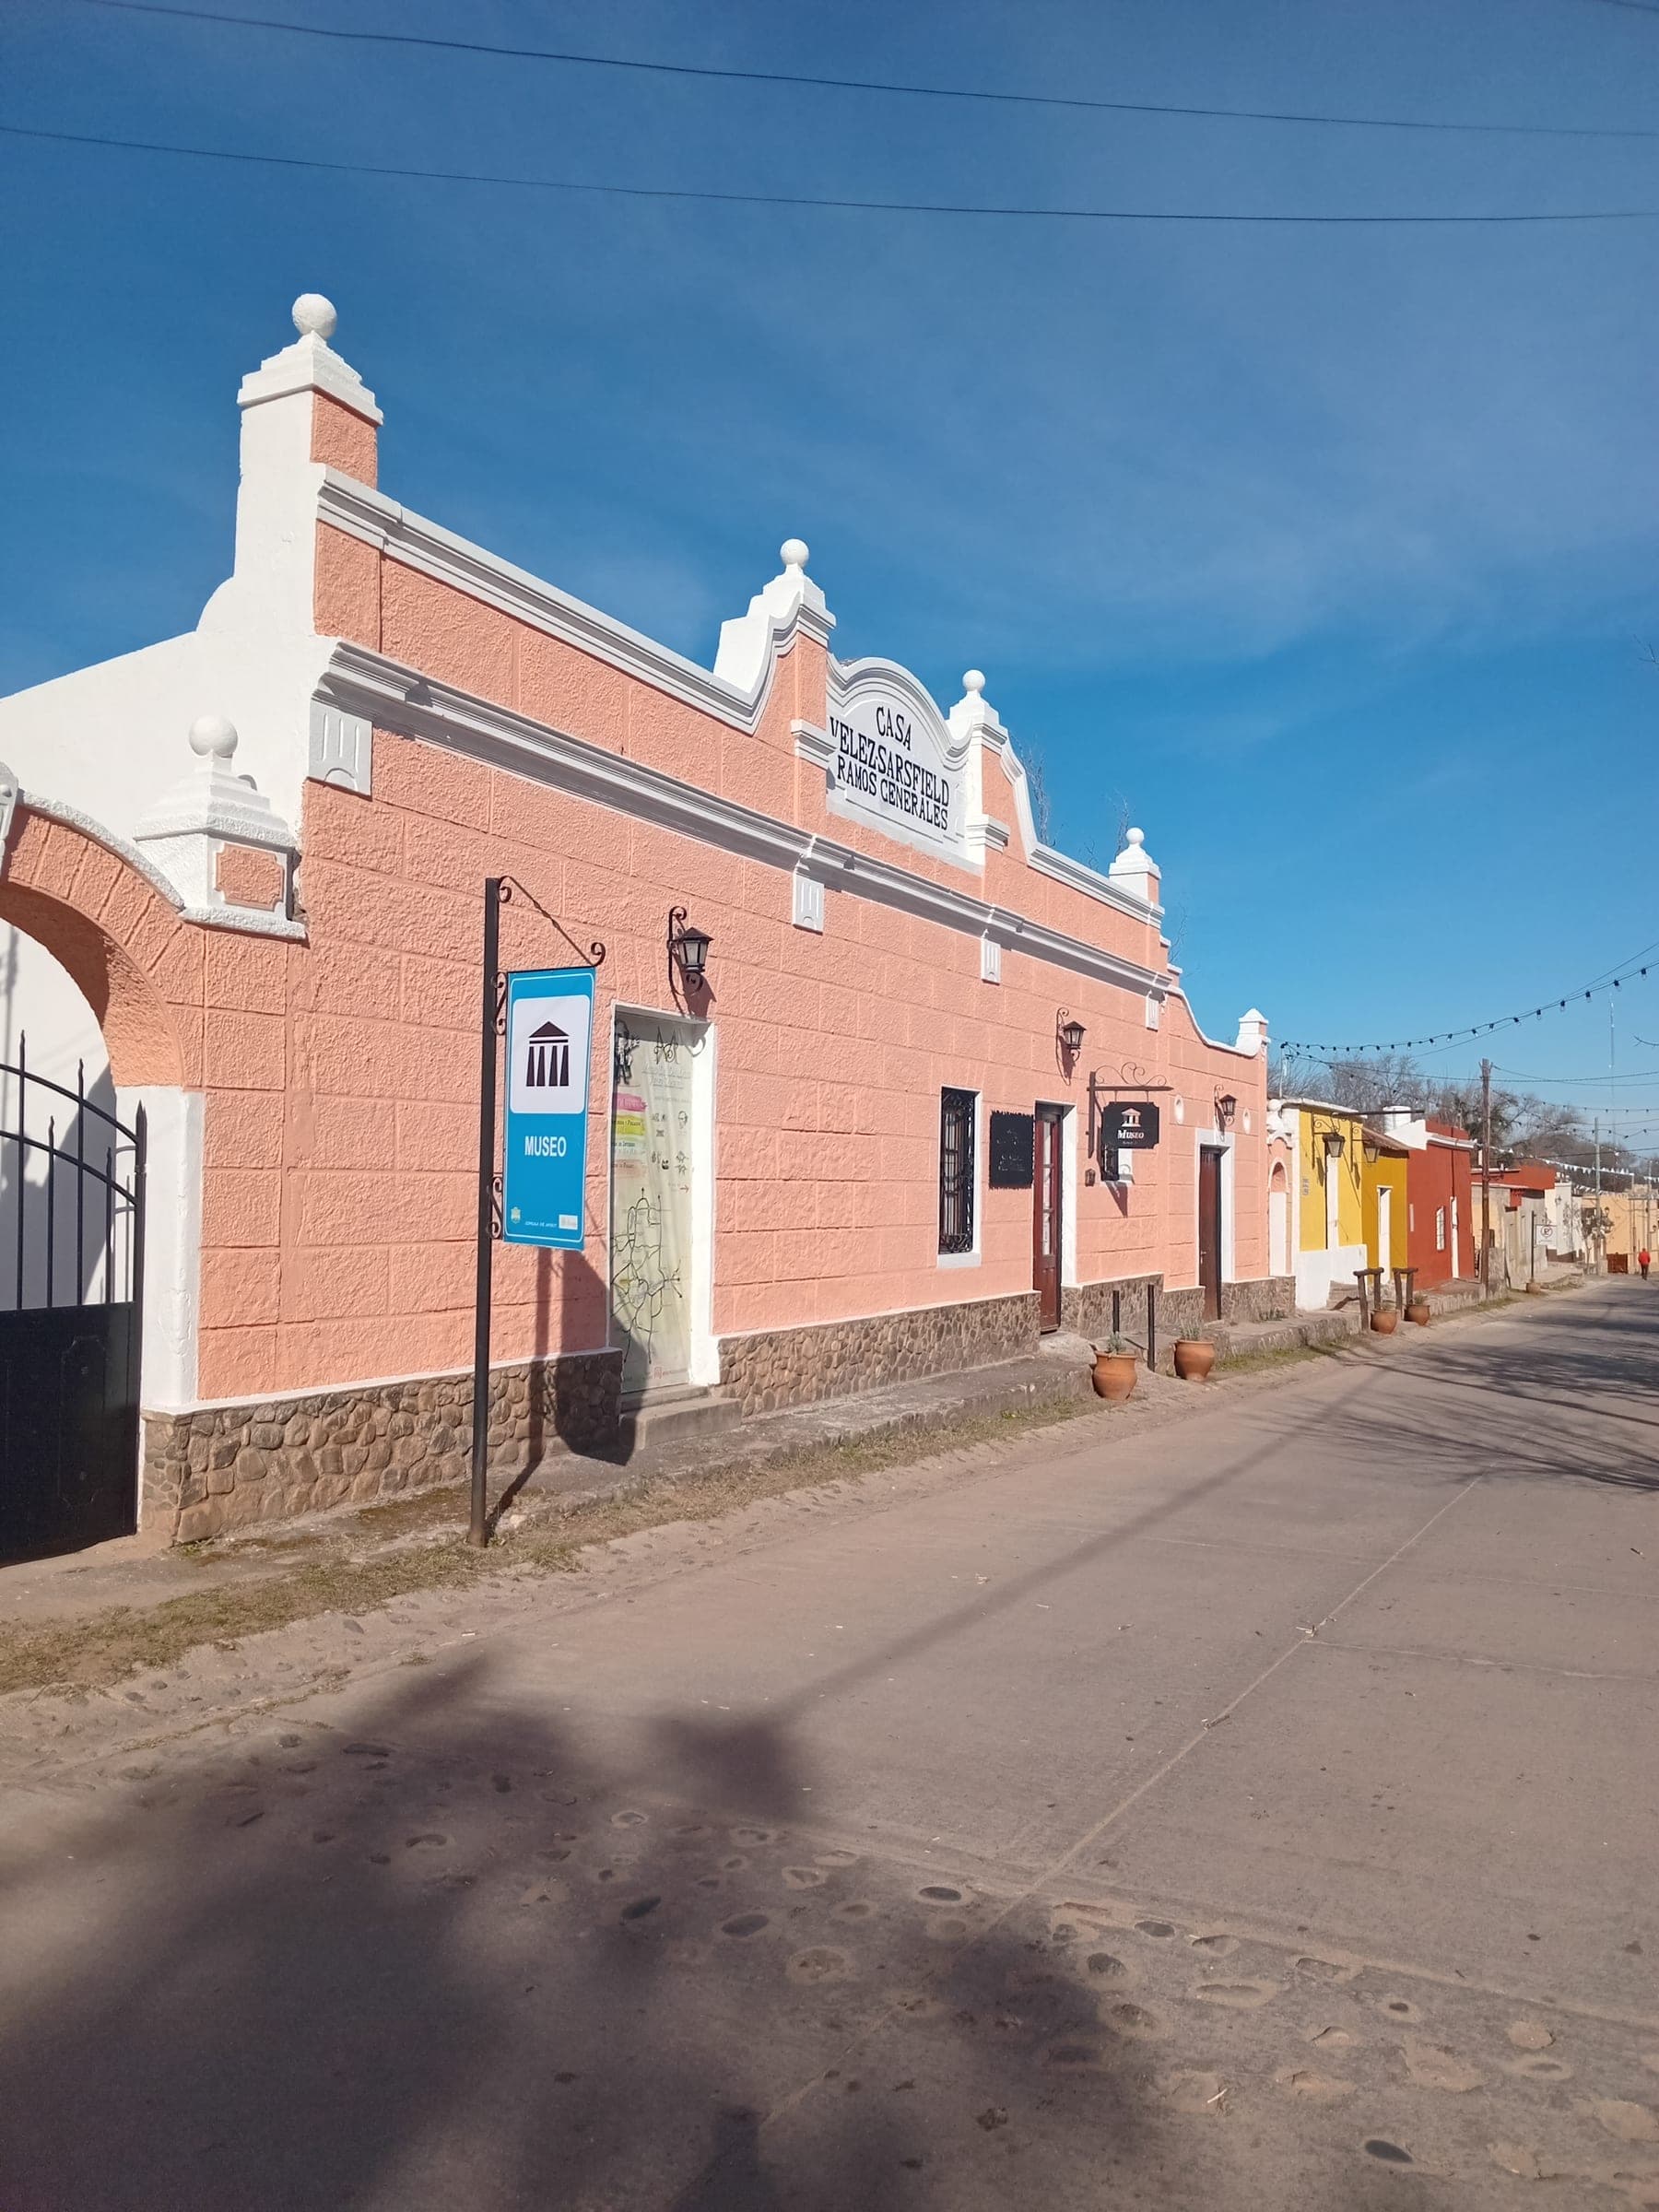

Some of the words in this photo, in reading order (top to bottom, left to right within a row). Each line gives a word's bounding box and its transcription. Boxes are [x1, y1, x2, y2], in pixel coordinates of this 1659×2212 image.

[876, 706, 912, 751] CASA
[837, 755, 877, 797] RAMOS
[879, 778, 948, 831] GENERALES
[524, 1135, 567, 1158] MUSEO
